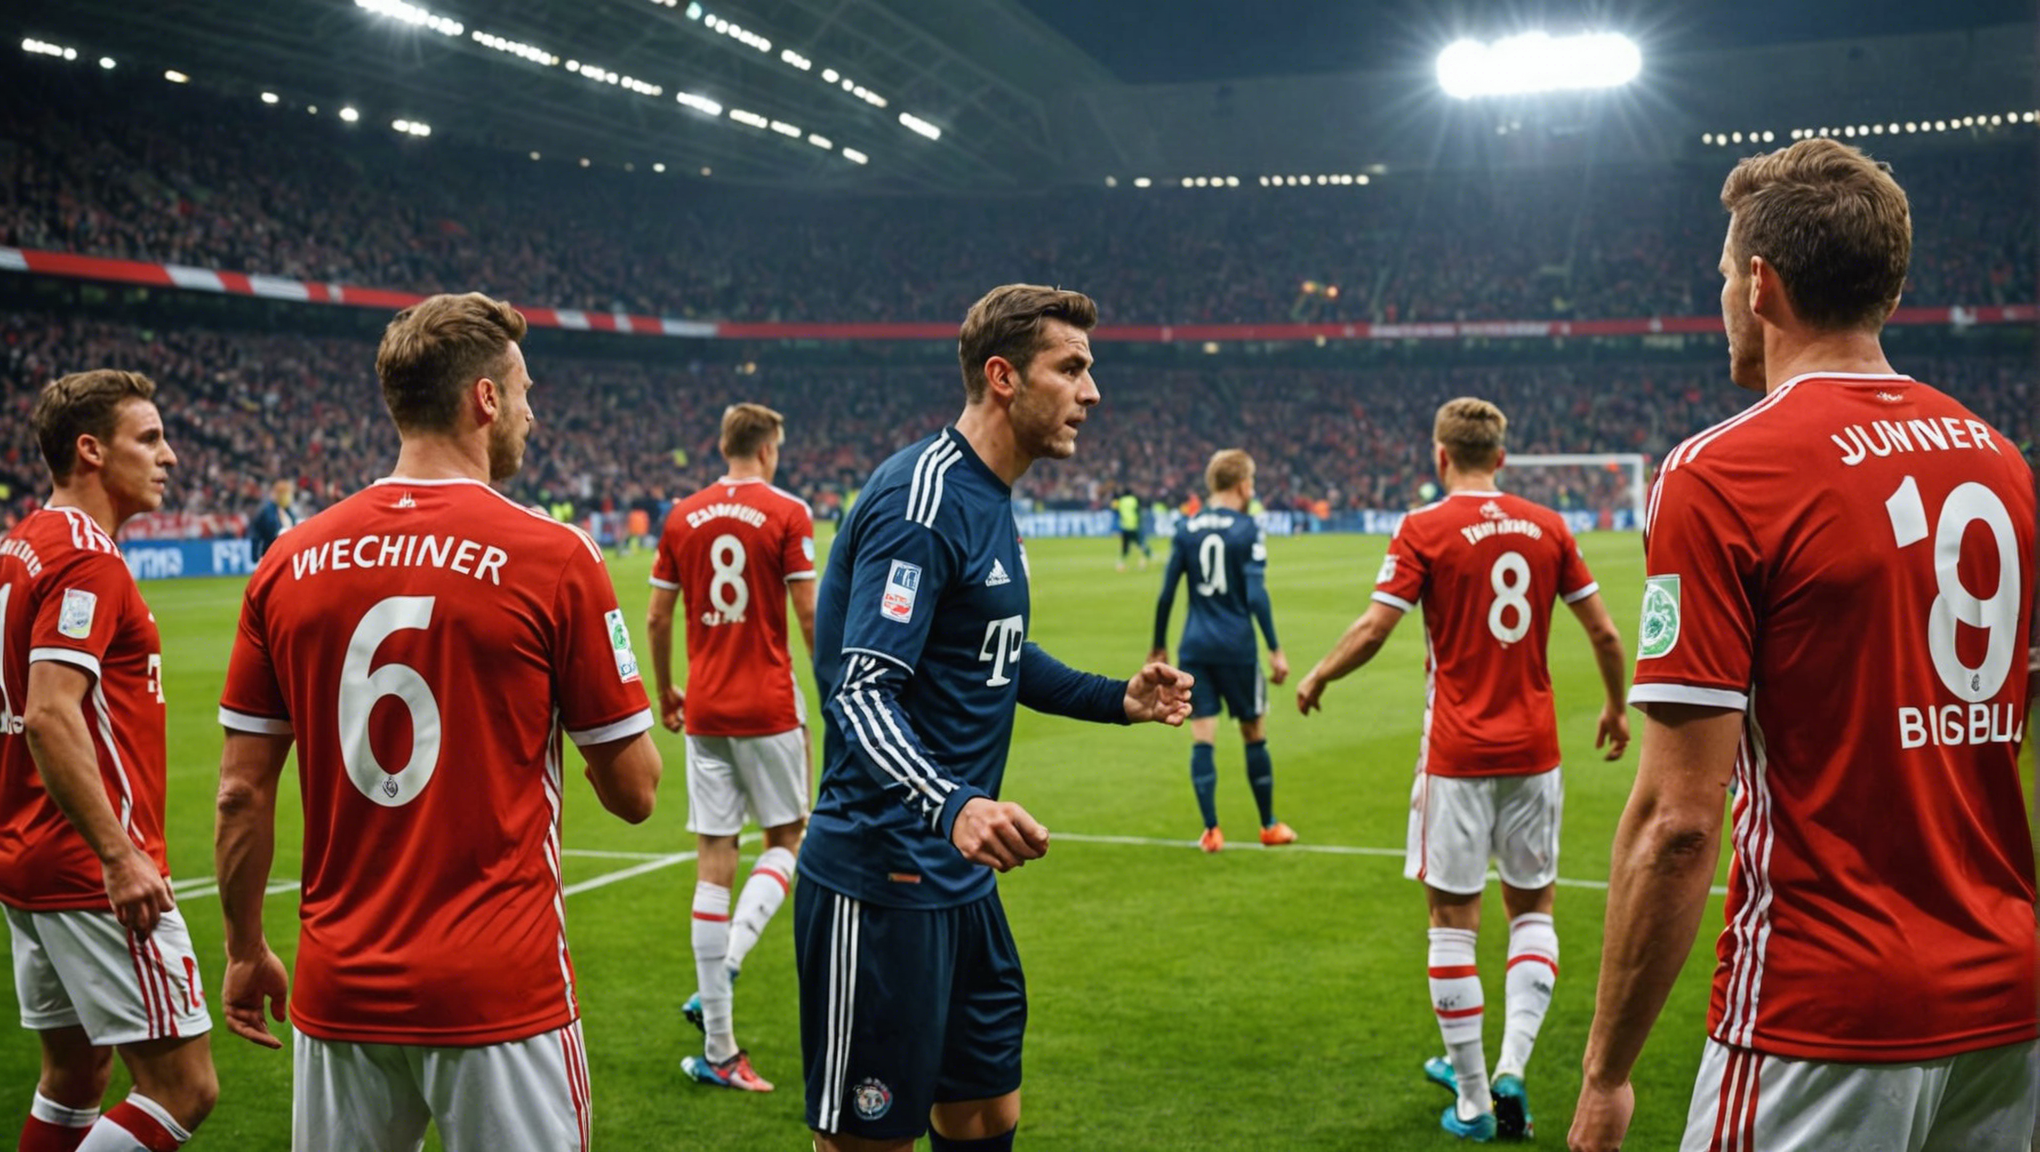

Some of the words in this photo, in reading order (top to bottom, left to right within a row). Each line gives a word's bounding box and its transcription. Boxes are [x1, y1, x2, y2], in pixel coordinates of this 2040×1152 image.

[710, 534, 749, 614] 8
[1488, 551, 1532, 643] 8
[338, 595, 442, 807] 6
